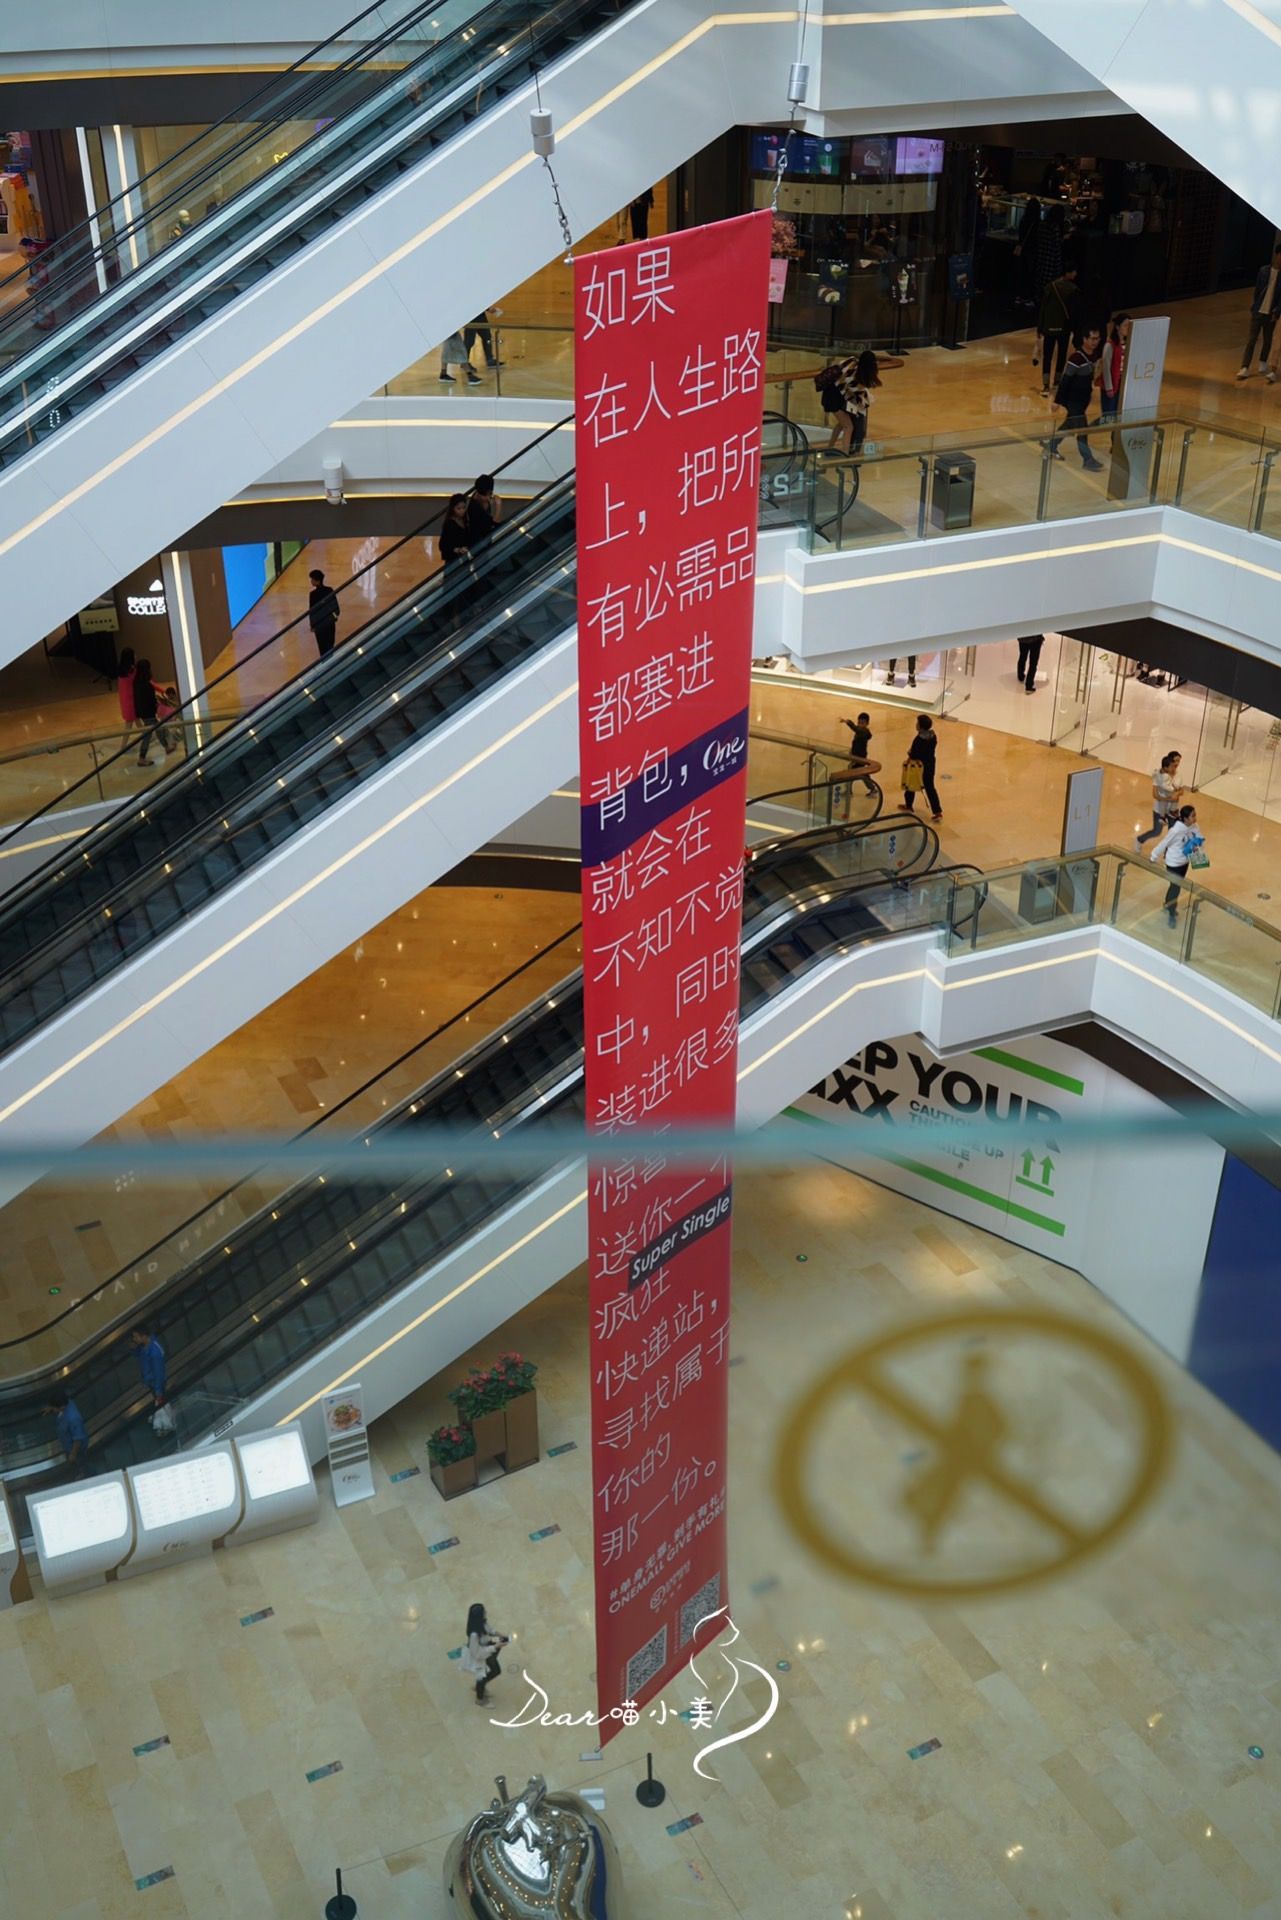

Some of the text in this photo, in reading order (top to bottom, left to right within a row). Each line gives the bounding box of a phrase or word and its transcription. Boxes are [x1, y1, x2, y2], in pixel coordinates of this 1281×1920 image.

[582, 246, 676, 341] 如果
[583, 328, 761, 448] 在人生路
[678, 426, 760, 515] 把所
[586, 526, 755, 648] 有必需品
[588, 630, 714, 742] 都塞进
[703, 736, 745, 770] One
[590, 806, 712, 915] 就会在
[593, 856, 744, 987] 不知不觉
[676, 931, 742, 1018] 同时
[594, 1007, 738, 1137] 装进很多
[632, 1196, 730, 1279] Super Single
[594, 1267, 671, 1340] 疯狂
[598, 1318, 729, 1449] 寻找属于
[598, 1432, 671, 1513] 你的
